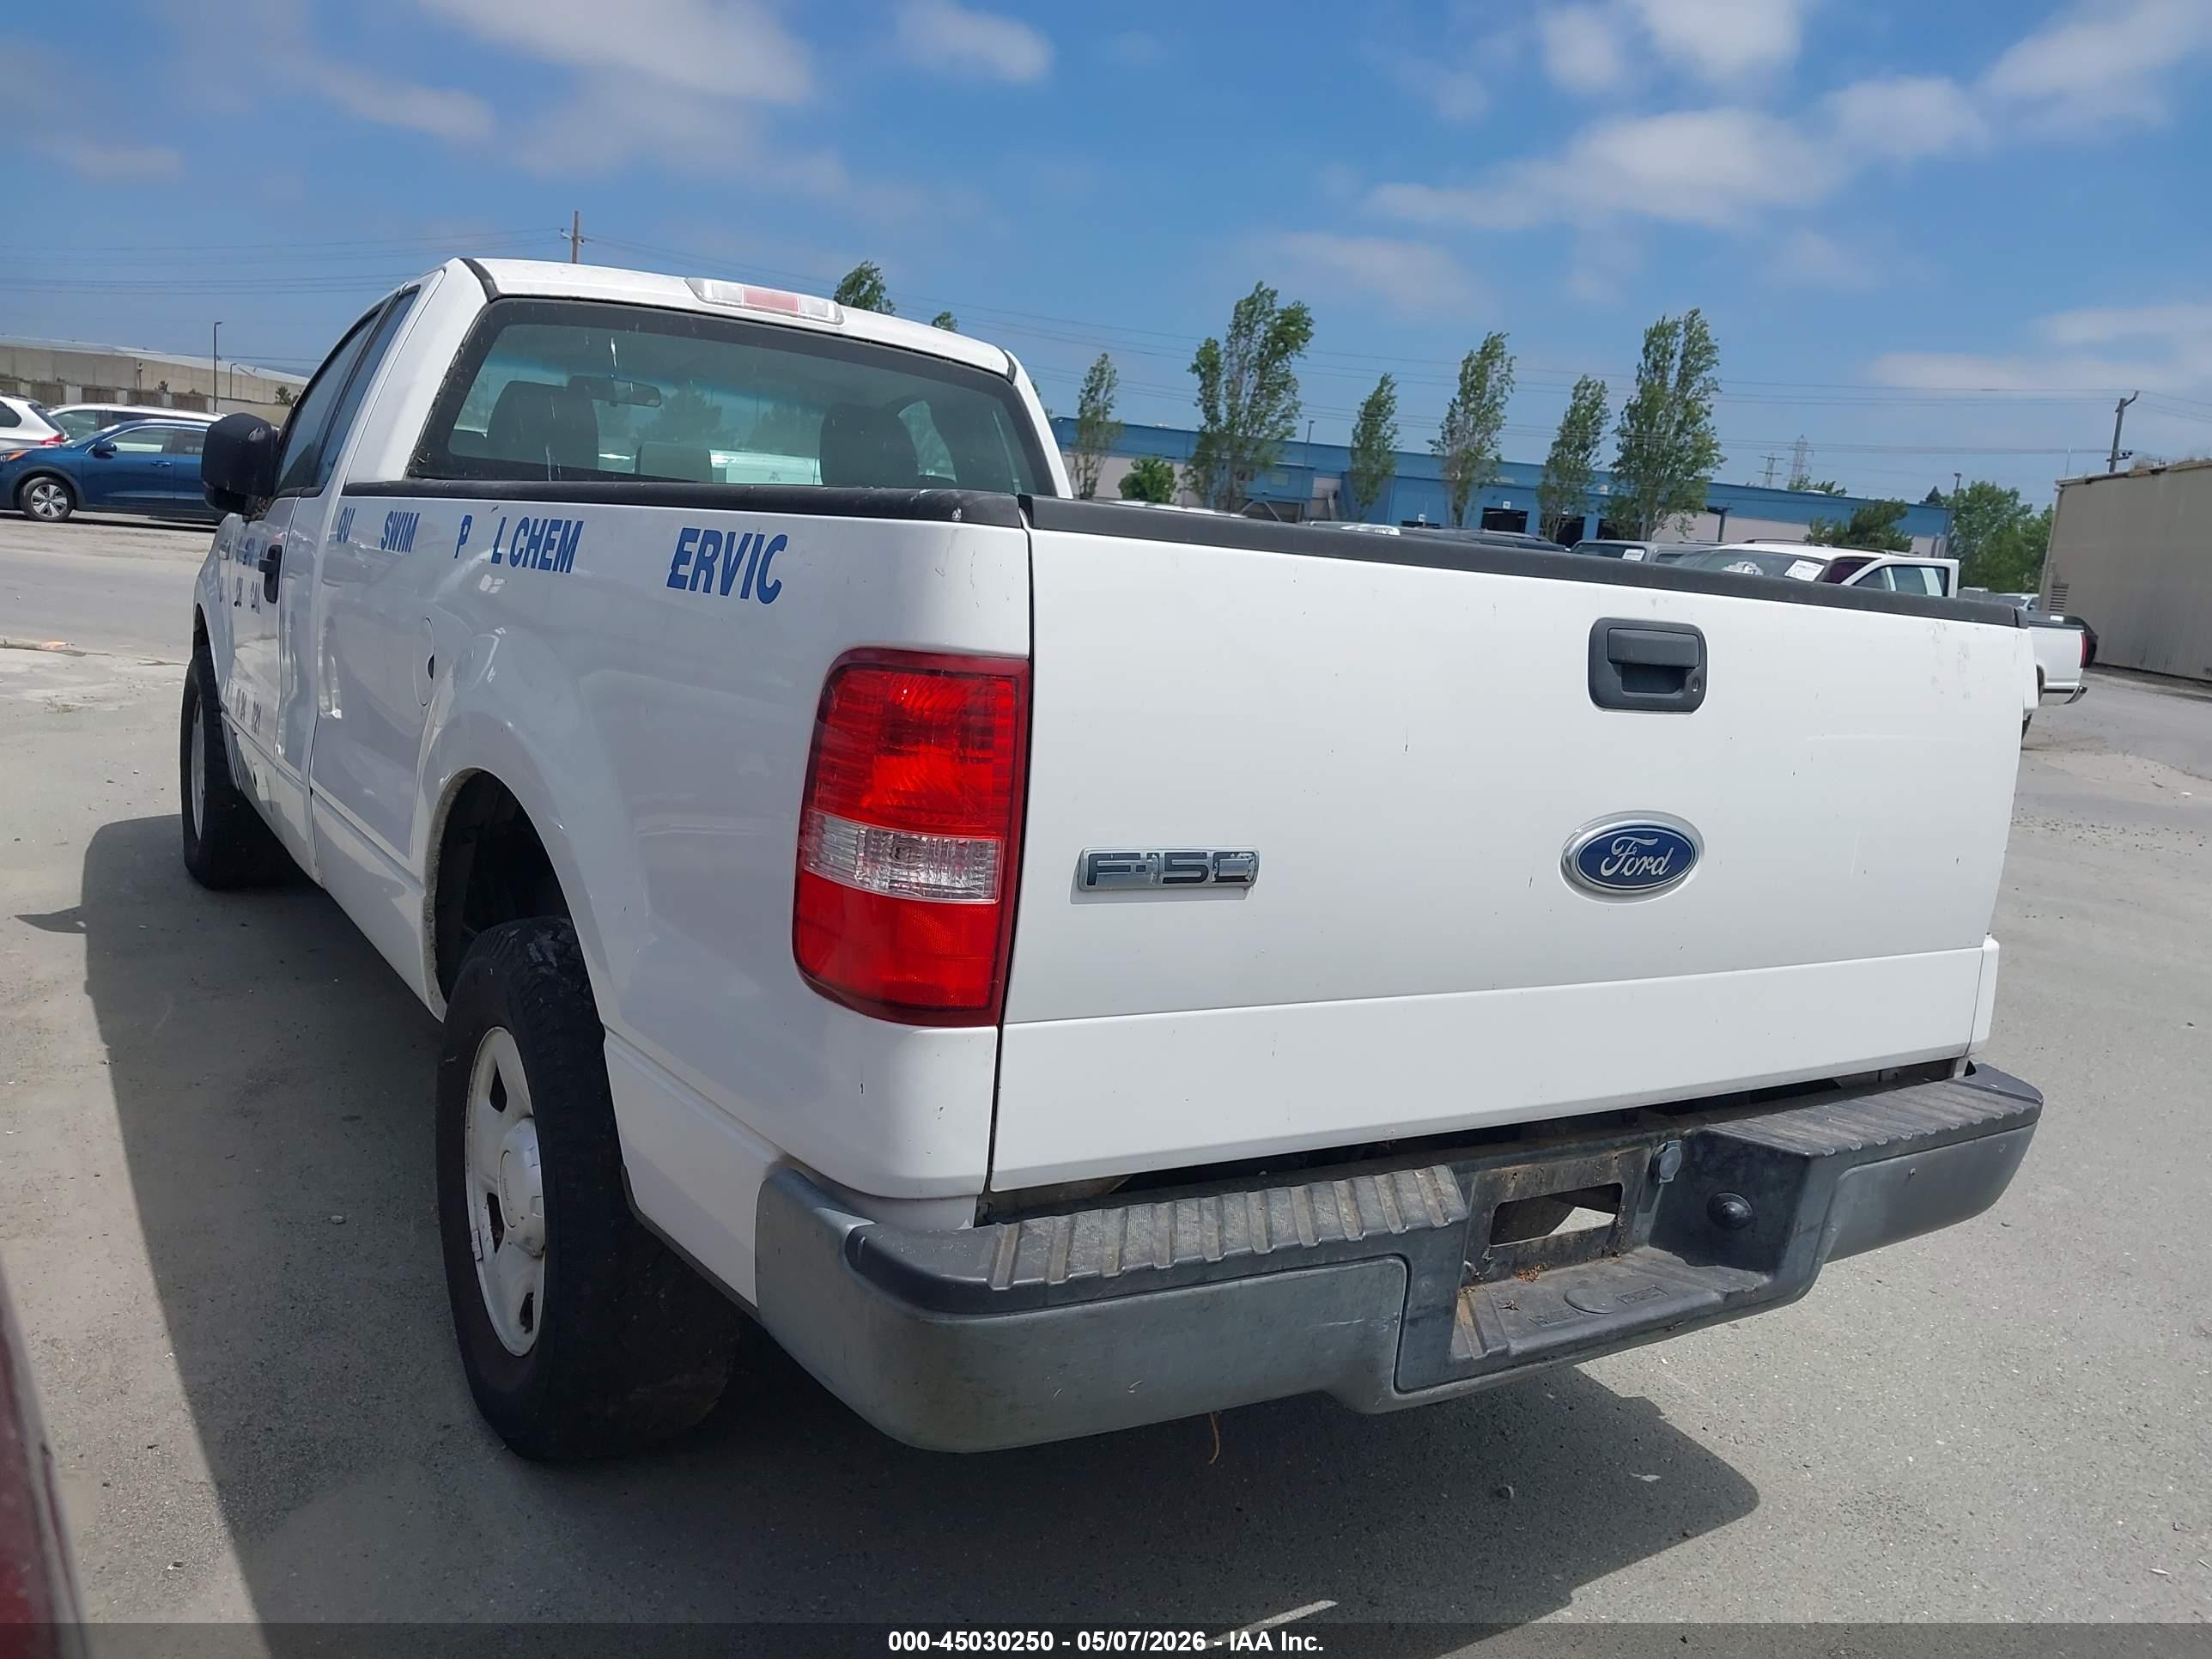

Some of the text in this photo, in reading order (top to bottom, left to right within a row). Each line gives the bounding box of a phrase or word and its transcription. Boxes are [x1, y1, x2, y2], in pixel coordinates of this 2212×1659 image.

[380, 510, 421, 553] SWIM
[508, 517, 584, 574] CHEM
[666, 527, 788, 605] ERVIC
[1085, 850, 1256, 886] F-150
[1601, 836, 1674, 877] Ford
